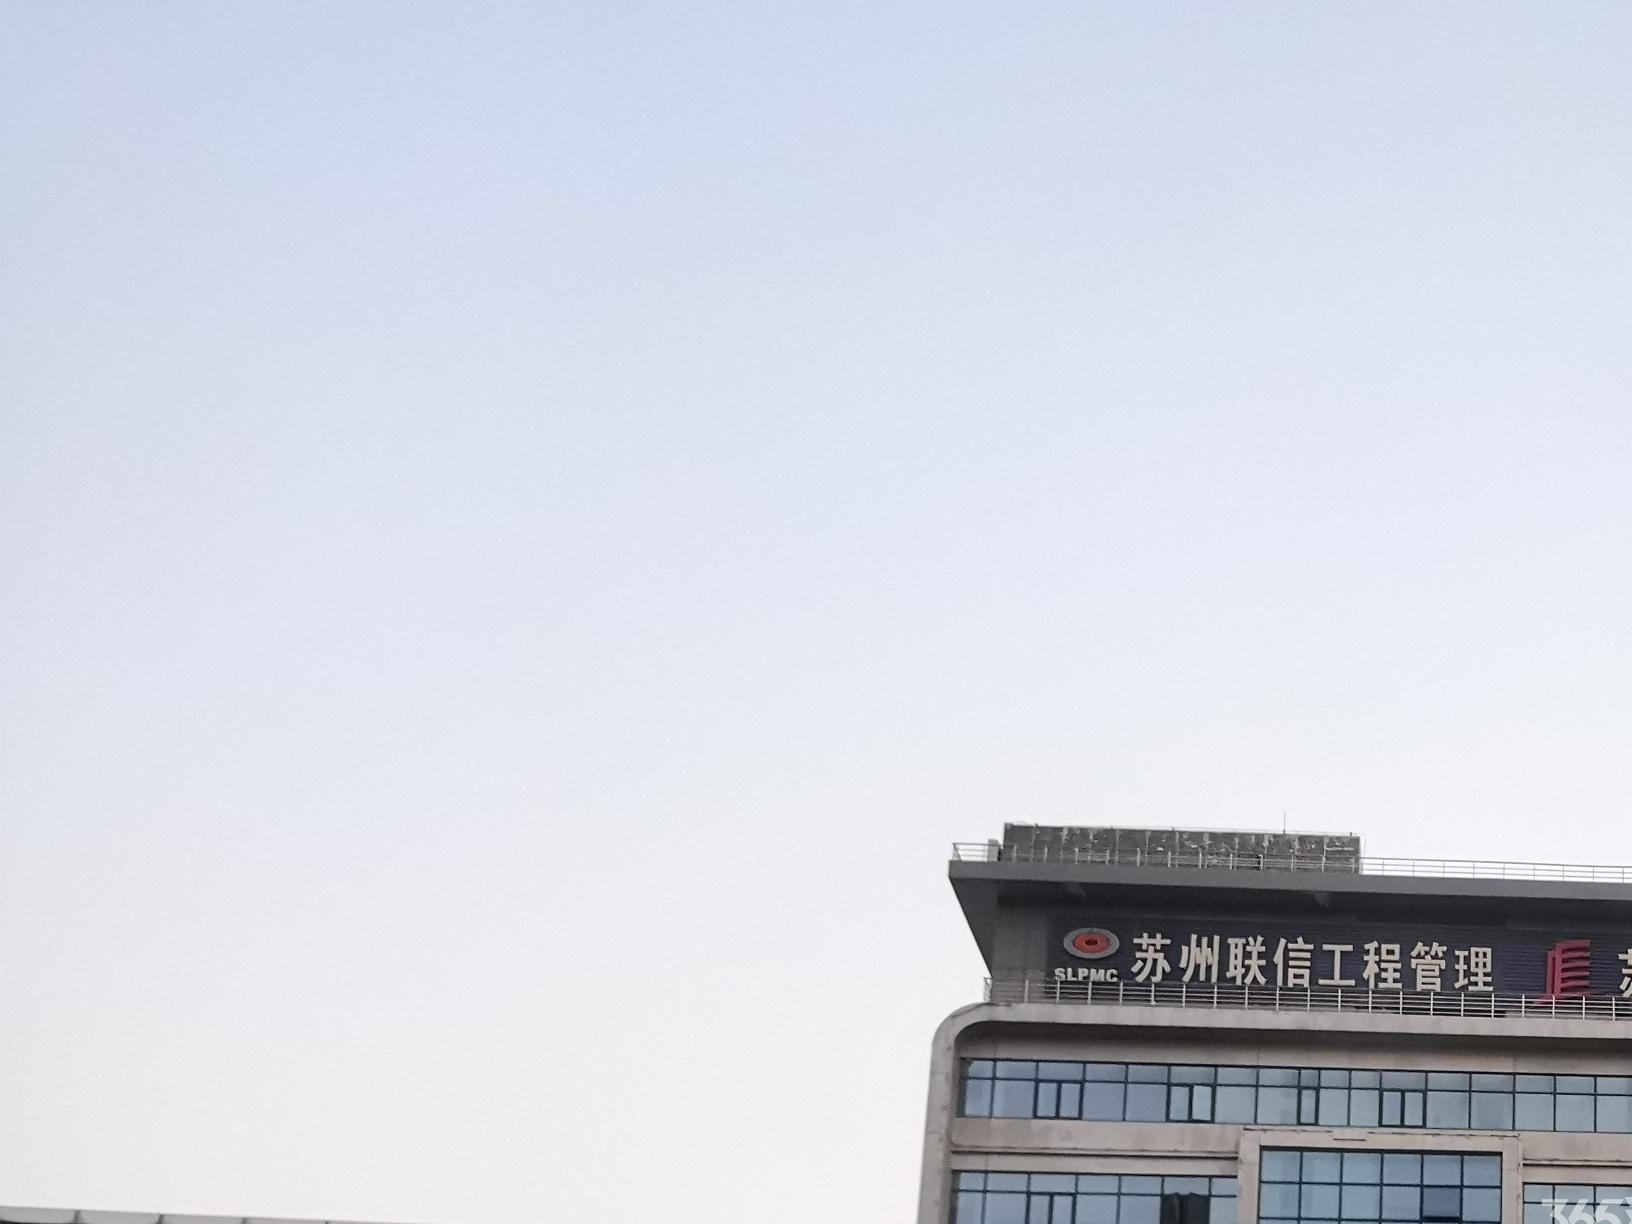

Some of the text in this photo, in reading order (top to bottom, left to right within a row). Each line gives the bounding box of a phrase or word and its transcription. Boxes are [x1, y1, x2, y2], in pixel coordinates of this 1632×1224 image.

[1054, 967, 1119, 982] SLPMC
[1131, 933, 1494, 992] 苏州联信工程管理
